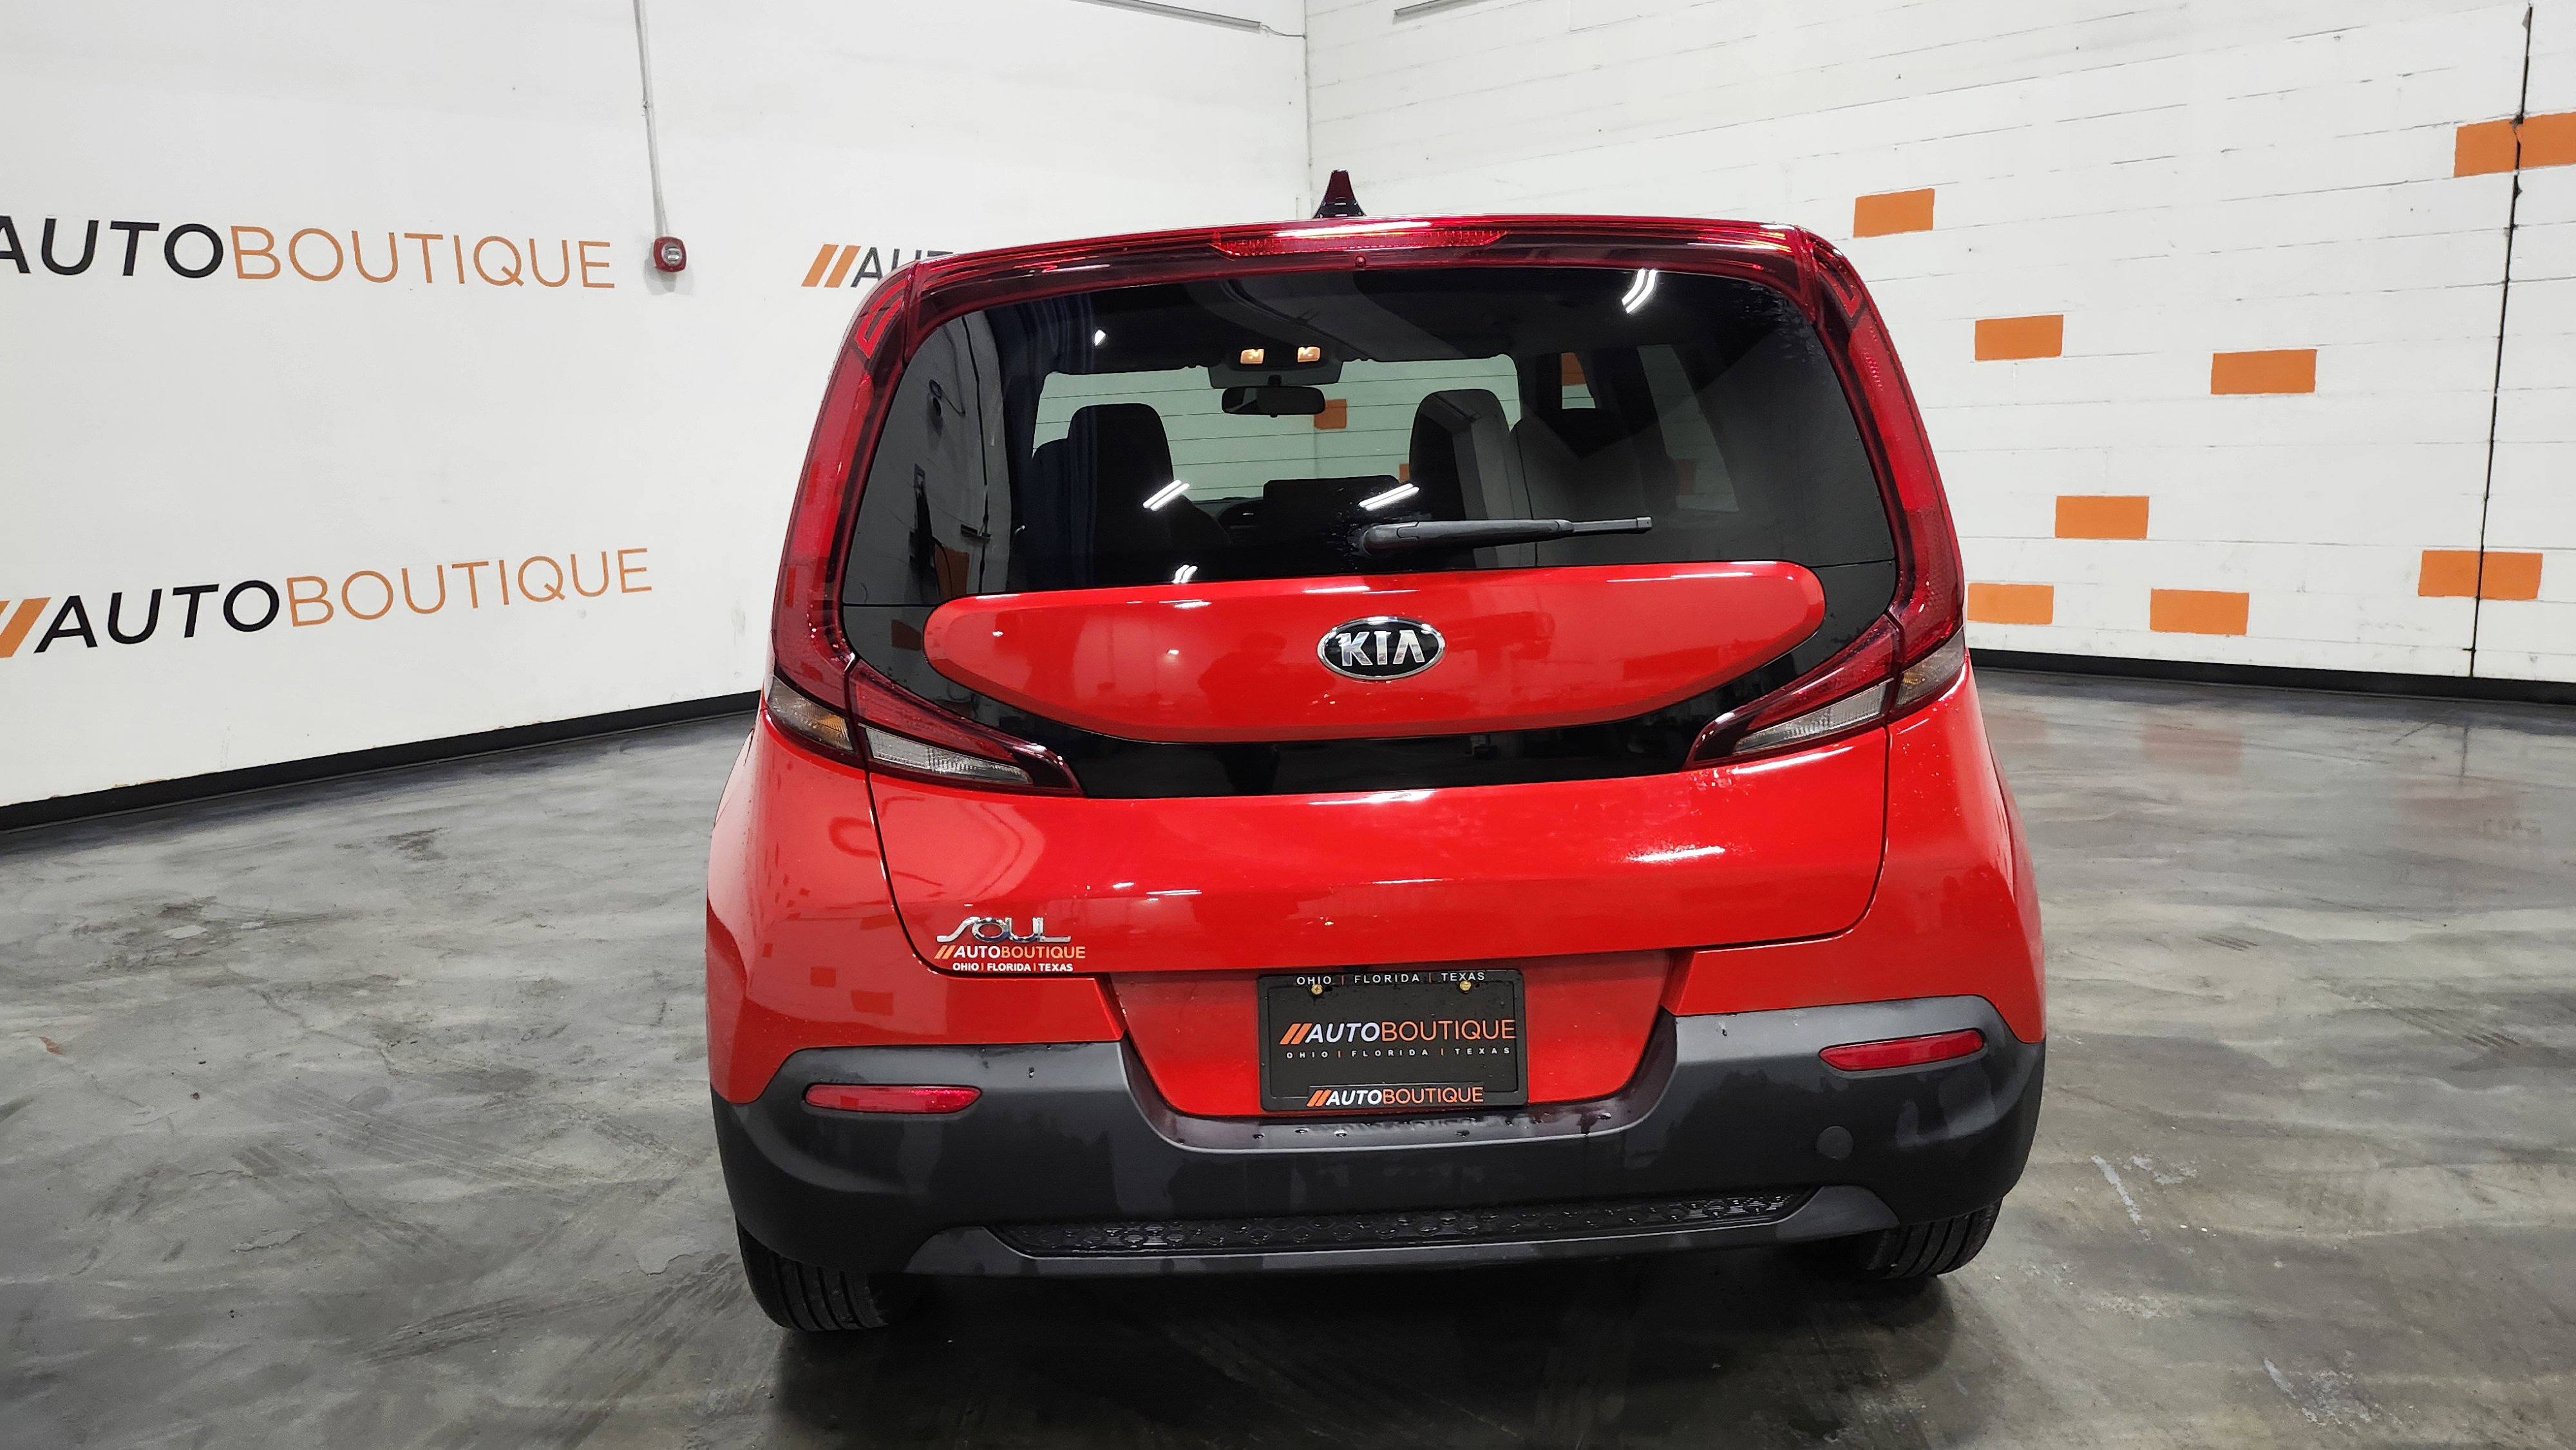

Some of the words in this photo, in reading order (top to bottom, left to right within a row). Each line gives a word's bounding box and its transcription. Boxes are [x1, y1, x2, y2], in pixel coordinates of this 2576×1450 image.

[1336, 629, 1426, 666] KIA
[936, 916, 1072, 943] SOUL
[953, 945, 1086, 959] AUTOBOUTIQUE
[952, 962, 980, 972] OHIO
[987, 962, 1032, 972] FLORIDA
[1037, 963, 1074, 972] TEXAS
[1296, 975, 1332, 986] OHIO
[1354, 974, 1420, 984] FLORIDA
[1441, 972, 1486, 982] TEXAS
[1304, 1019, 1517, 1044] AUTOBOUTIQUE
[1285, 1050, 1329, 1059] OHIO
[1350, 1048, 1428, 1058] FLORIDA
[1454, 1046, 1510, 1055] TEXAS
[1325, 1086, 1484, 1107] AUTOBOUTIQUE
